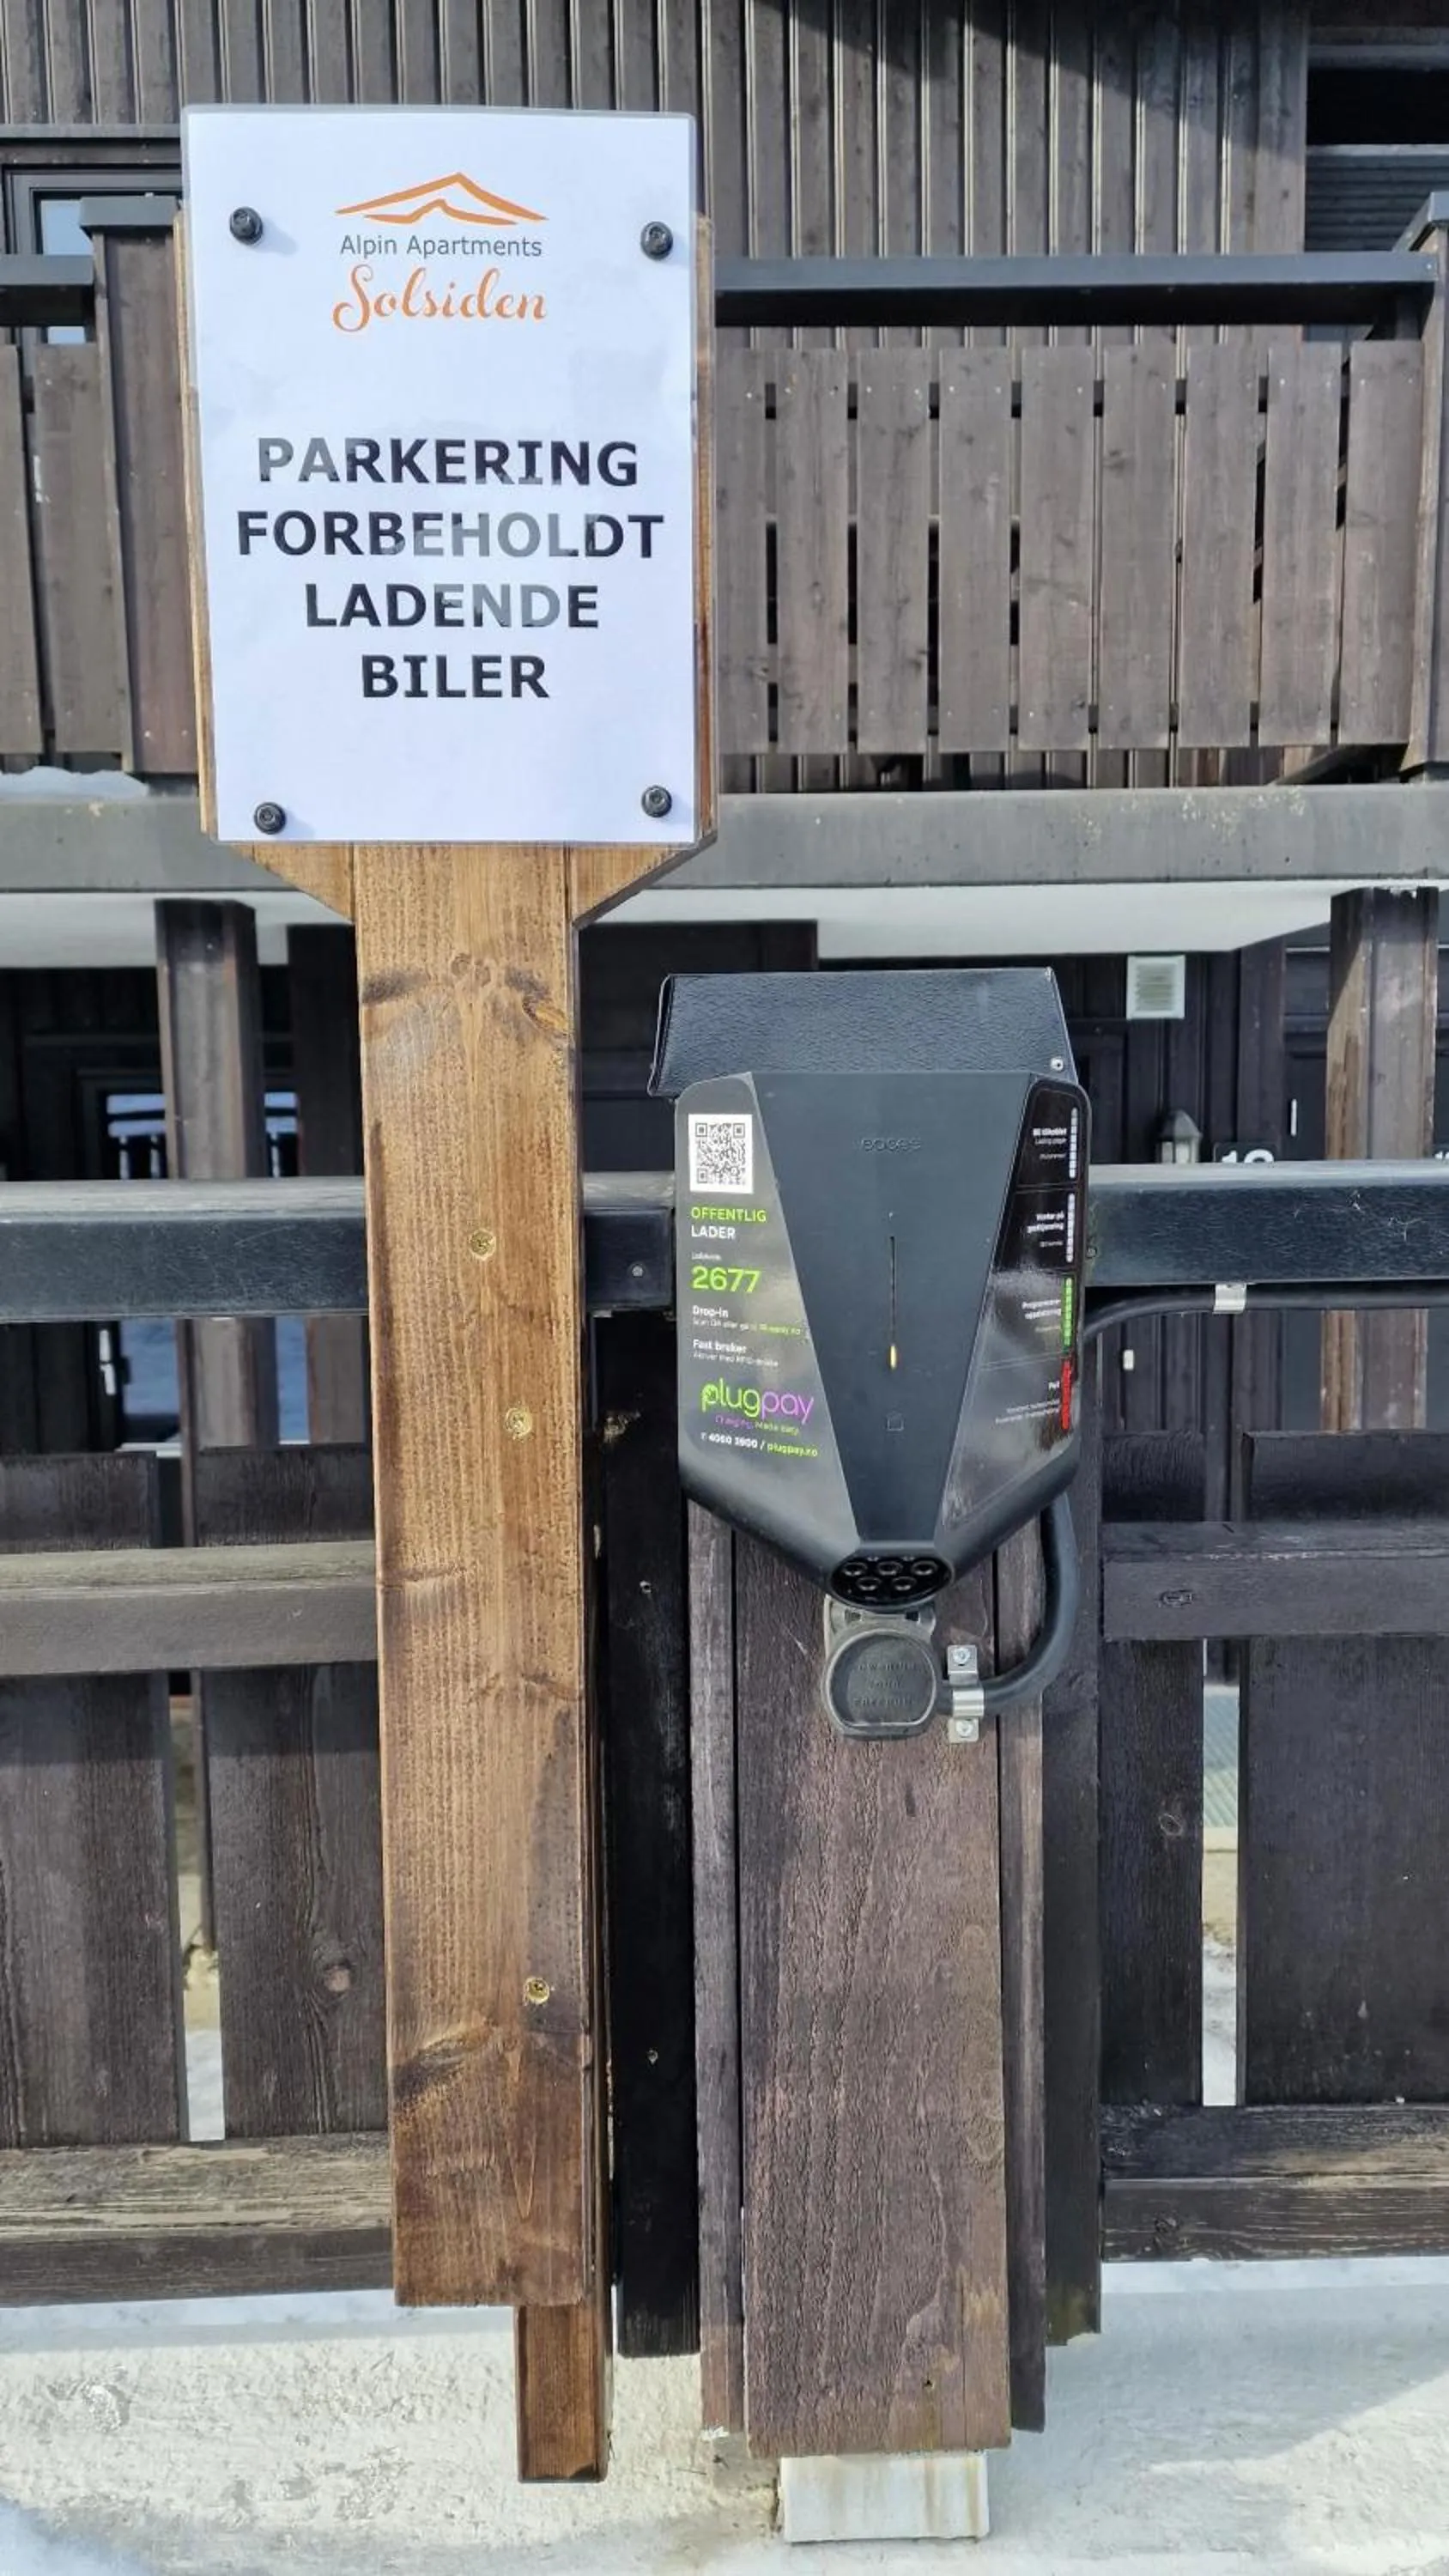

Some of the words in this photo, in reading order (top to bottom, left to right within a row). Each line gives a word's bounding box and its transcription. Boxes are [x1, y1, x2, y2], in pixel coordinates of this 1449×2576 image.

[340, 234, 397, 259] Alpin
[406, 234, 543, 258] Apartments
[332, 263, 547, 333] Solsiden
[258, 437, 638, 487] PARKERING
[237, 510, 664, 559] FORBEHOLDT
[305, 583, 600, 629] LADENDE
[361, 654, 551, 699] BILER
[690, 1206, 767, 1223] OFFENTLIG
[691, 1225, 736, 1240] LADER
[691, 1265, 761, 1293] 2677
[700, 1377, 815, 1426] plugpay
